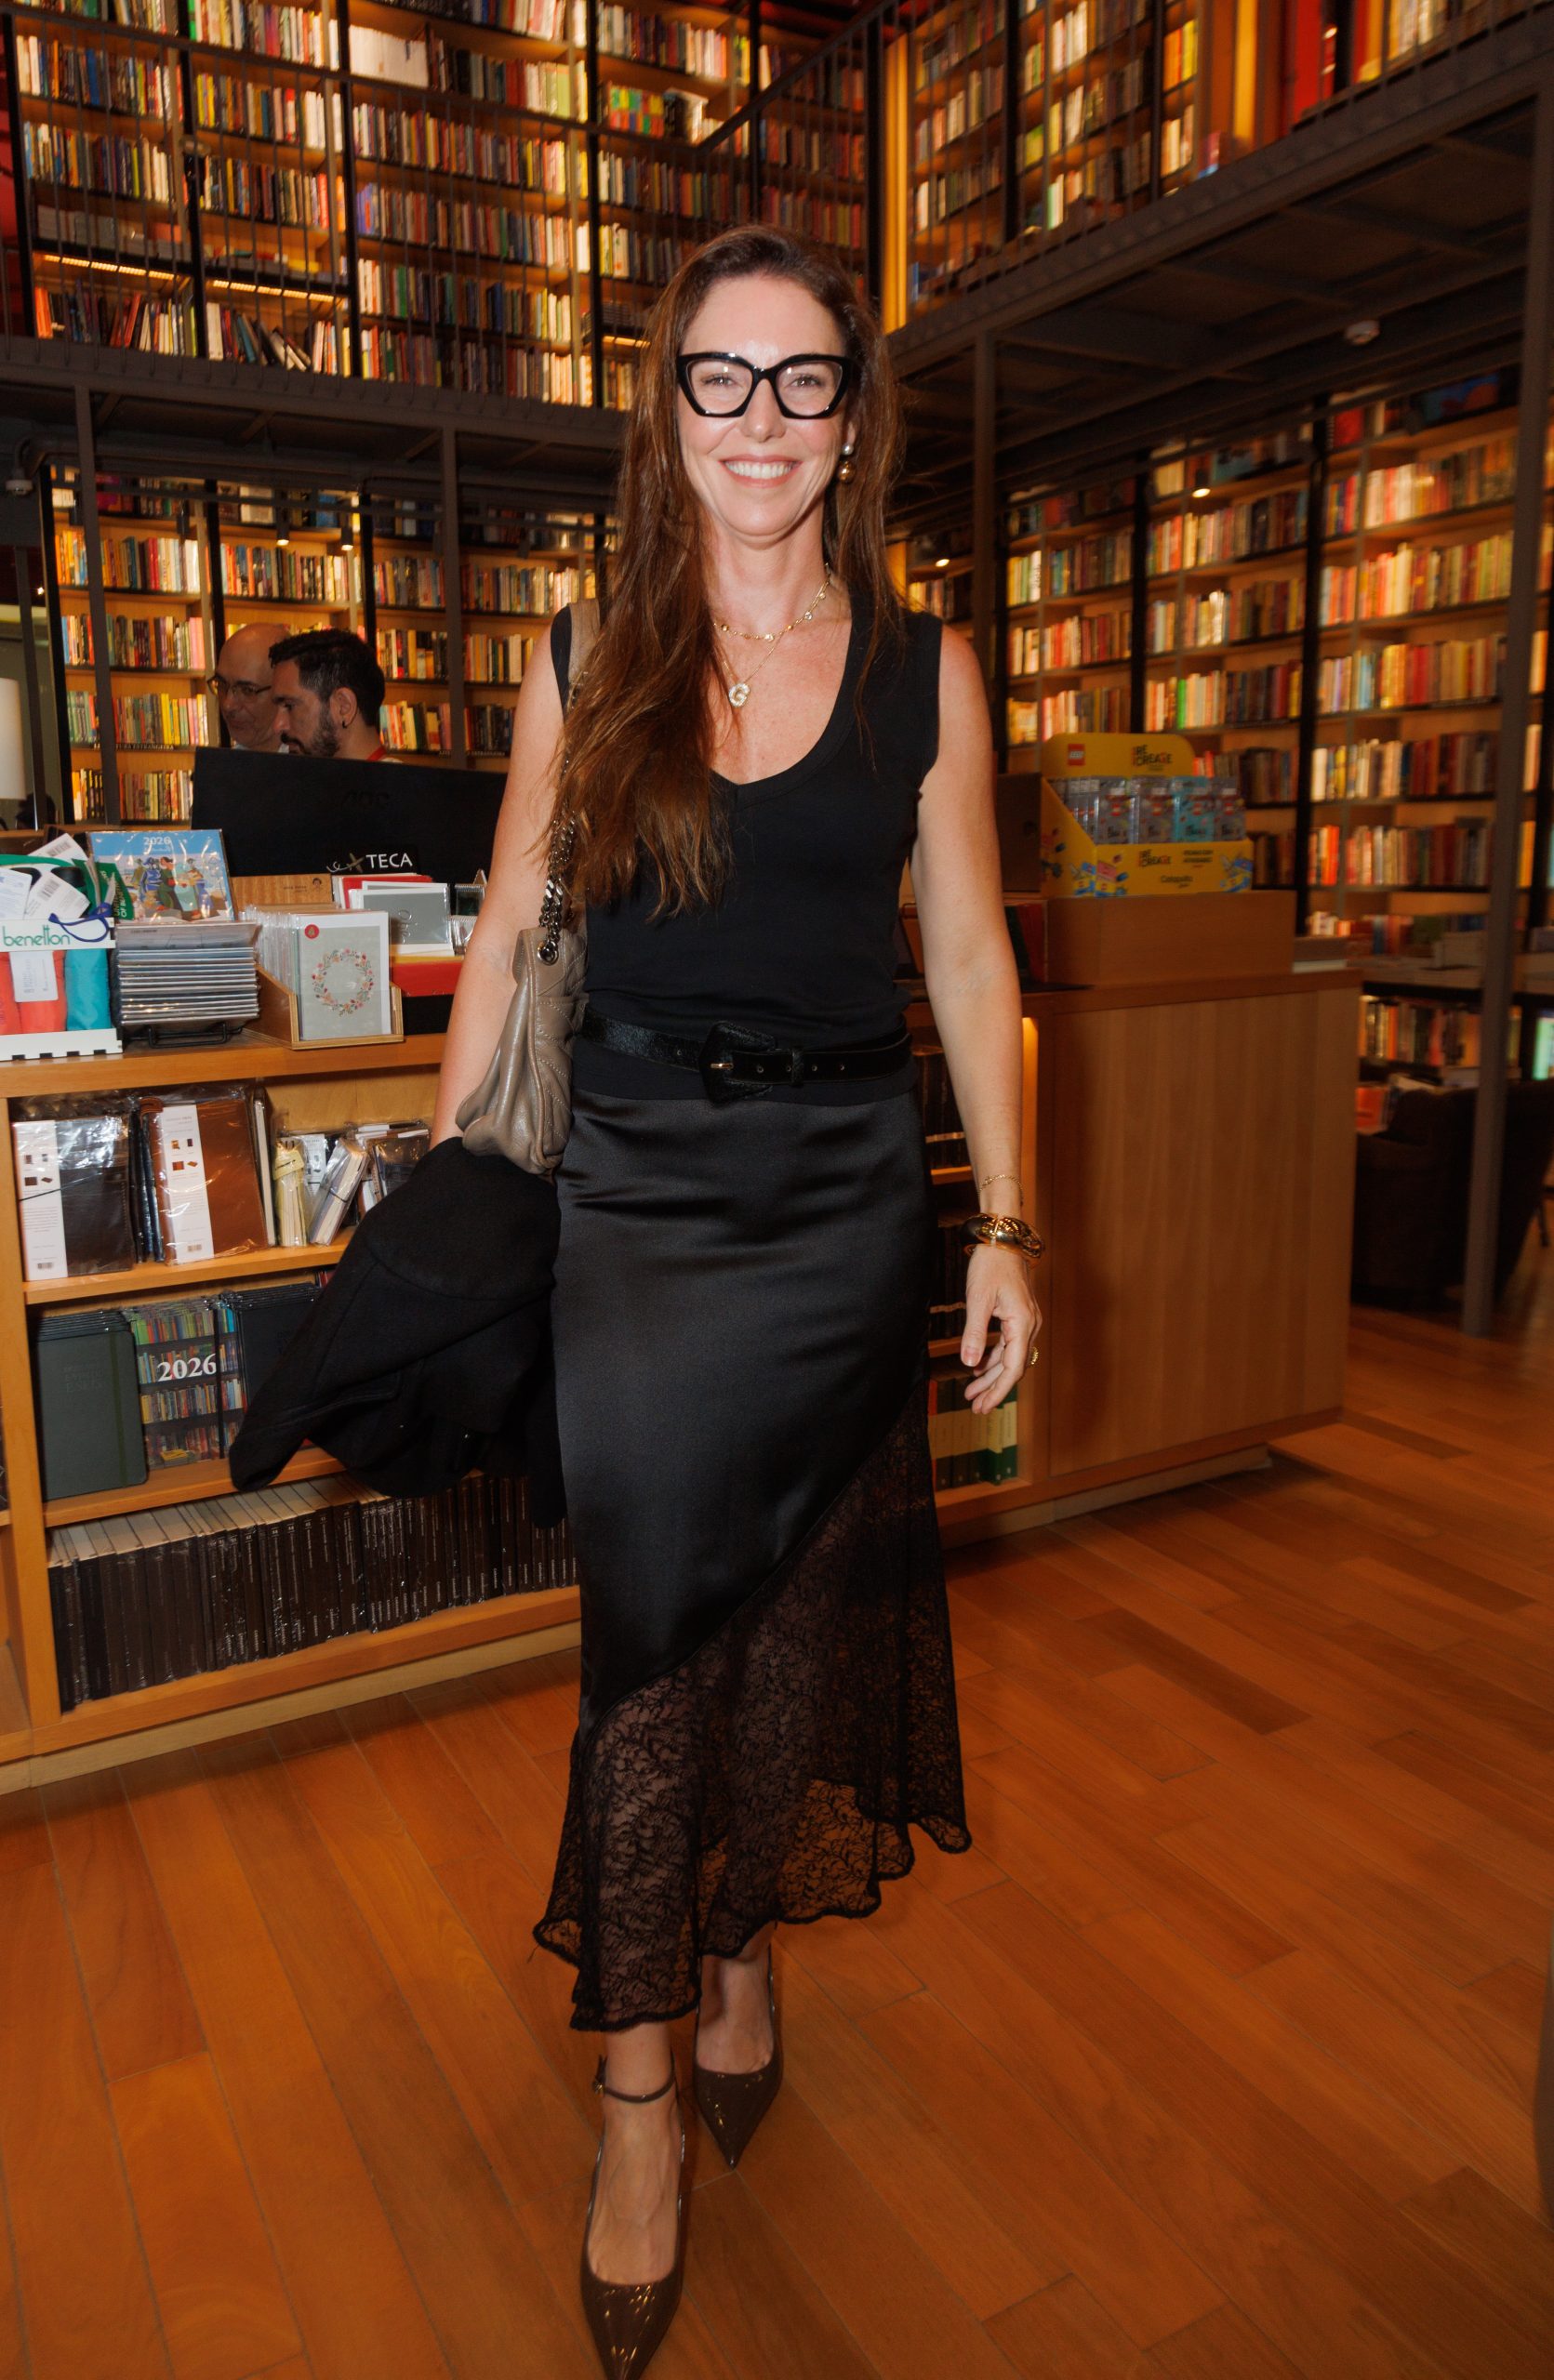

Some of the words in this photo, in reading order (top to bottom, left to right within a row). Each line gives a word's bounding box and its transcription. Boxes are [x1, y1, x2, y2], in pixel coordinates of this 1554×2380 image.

[142, 836, 172, 846] 2026
[365, 853, 413, 869] TECA
[2, 925, 71, 946] benetton
[156, 1353, 217, 1382] 2026
